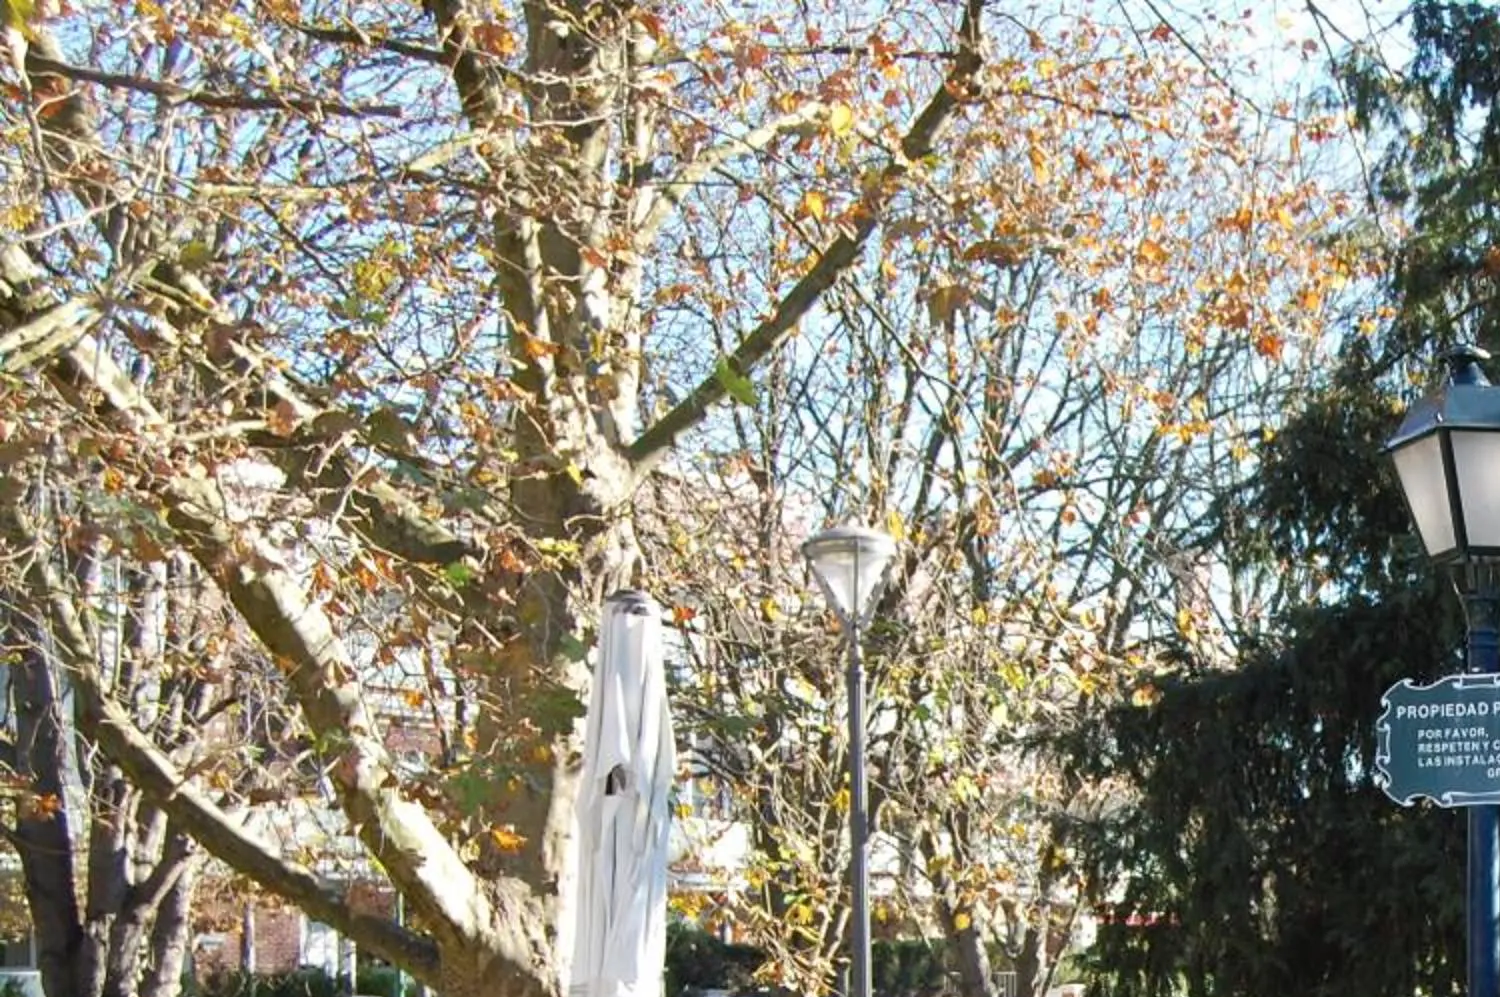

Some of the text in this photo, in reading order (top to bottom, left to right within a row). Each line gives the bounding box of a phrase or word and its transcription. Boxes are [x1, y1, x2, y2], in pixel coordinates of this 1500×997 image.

[1397, 703, 1488, 719] PROPIEDAD
[1417, 729, 1442, 740] POR
[1417, 741, 1480, 753] RESPETEN
[1417, 754, 1442, 768] LAS
